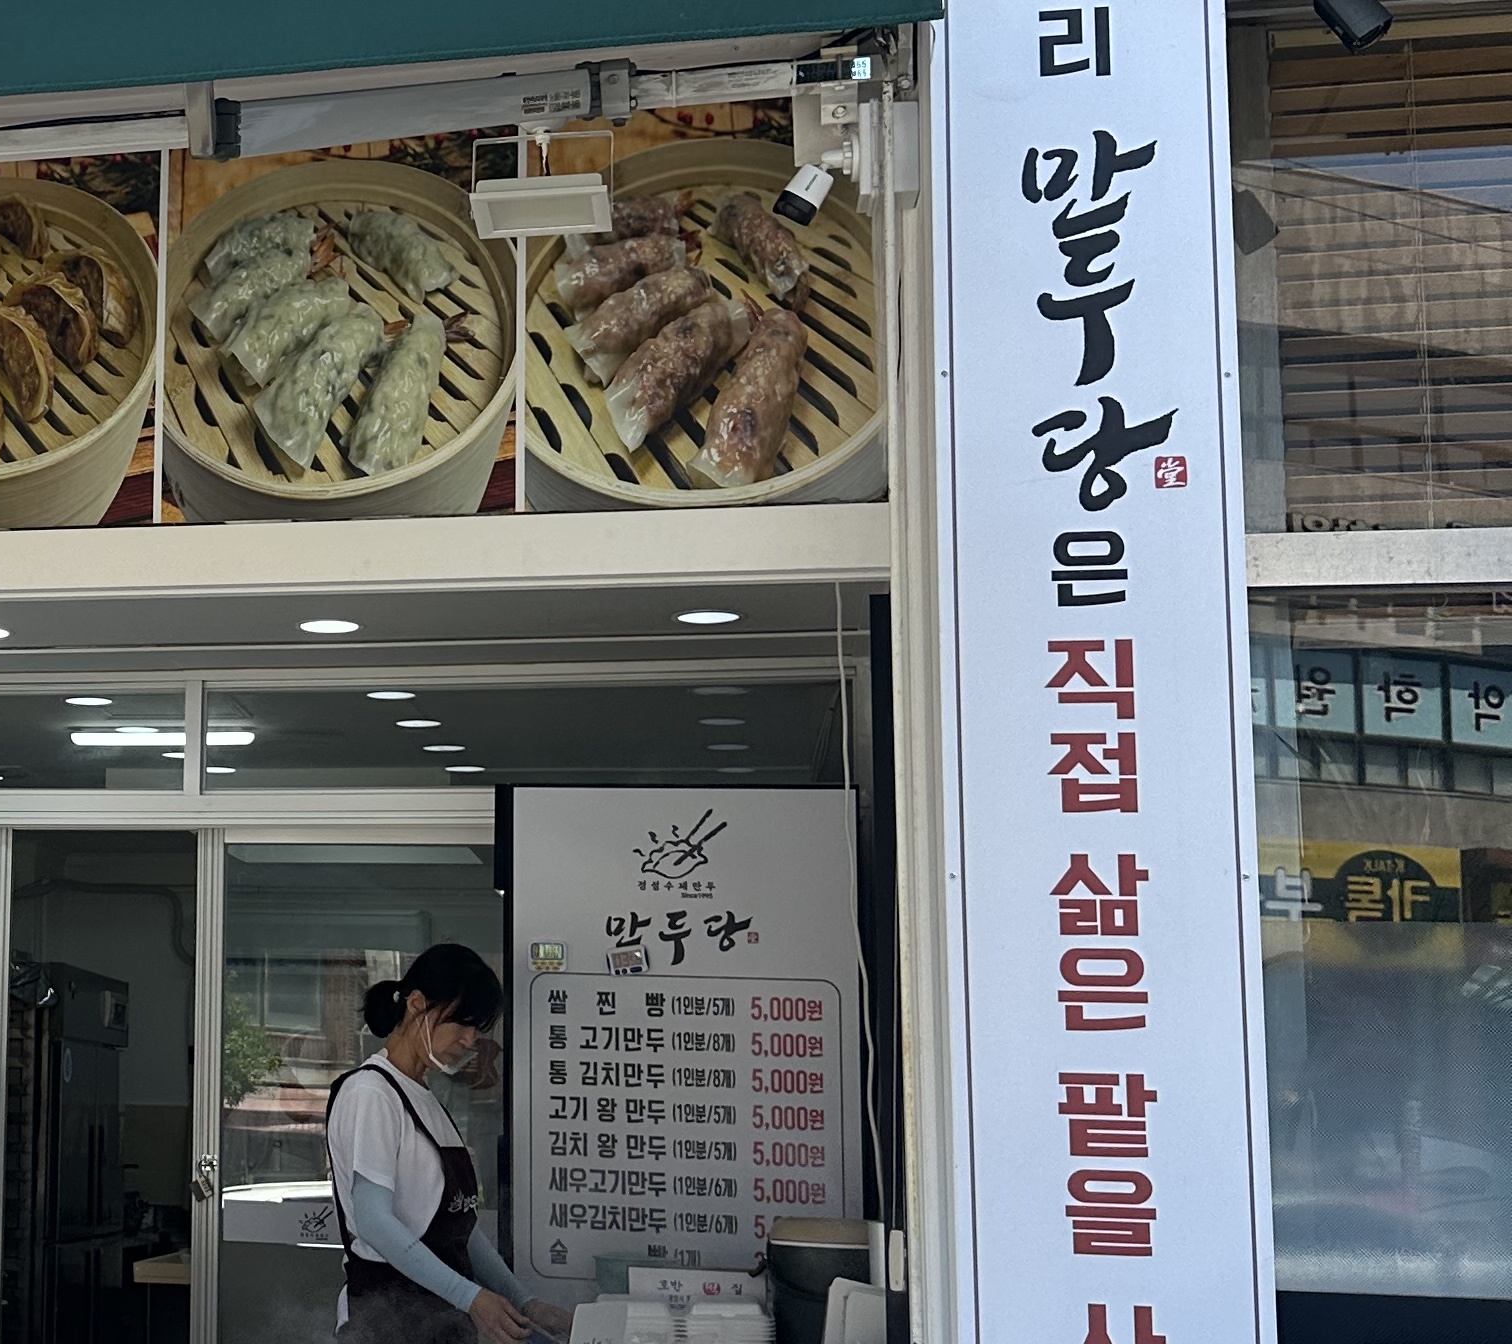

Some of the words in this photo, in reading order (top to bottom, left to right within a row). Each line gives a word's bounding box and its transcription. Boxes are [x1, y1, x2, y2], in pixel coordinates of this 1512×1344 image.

[1044, 638, 1140, 814] 직접
[605, 909, 754, 967] 만두당
[1050, 853, 1150, 1032] 삶은
[671, 995, 735, 1017] (1인분/5개)
[750, 996, 823, 1022] 5,000원
[579, 1025, 665, 1053] 고기만두
[671, 1032, 736, 1053] (1인분/8개)
[750, 1032, 824, 1058] 5,000원
[579, 1060, 665, 1089] 김치만두
[672, 1067, 736, 1089] (1인분/8개)
[751, 1068, 824, 1094] 5,000원
[672, 1103, 737, 1125] (1인분/5개)
[752, 1104, 825, 1131] 5,000원
[672, 1139, 737, 1162] (1인분/5개)
[752, 1141, 825, 1168] 5,000원
[1058, 1071, 1158, 1257] 팥을
[548, 1166, 667, 1197] 새우고기만두
[673, 1175, 738, 1198] (1인분/6개)
[753, 1177, 826, 1205] 5,000원
[549, 1202, 667, 1234] 새우김치만두
